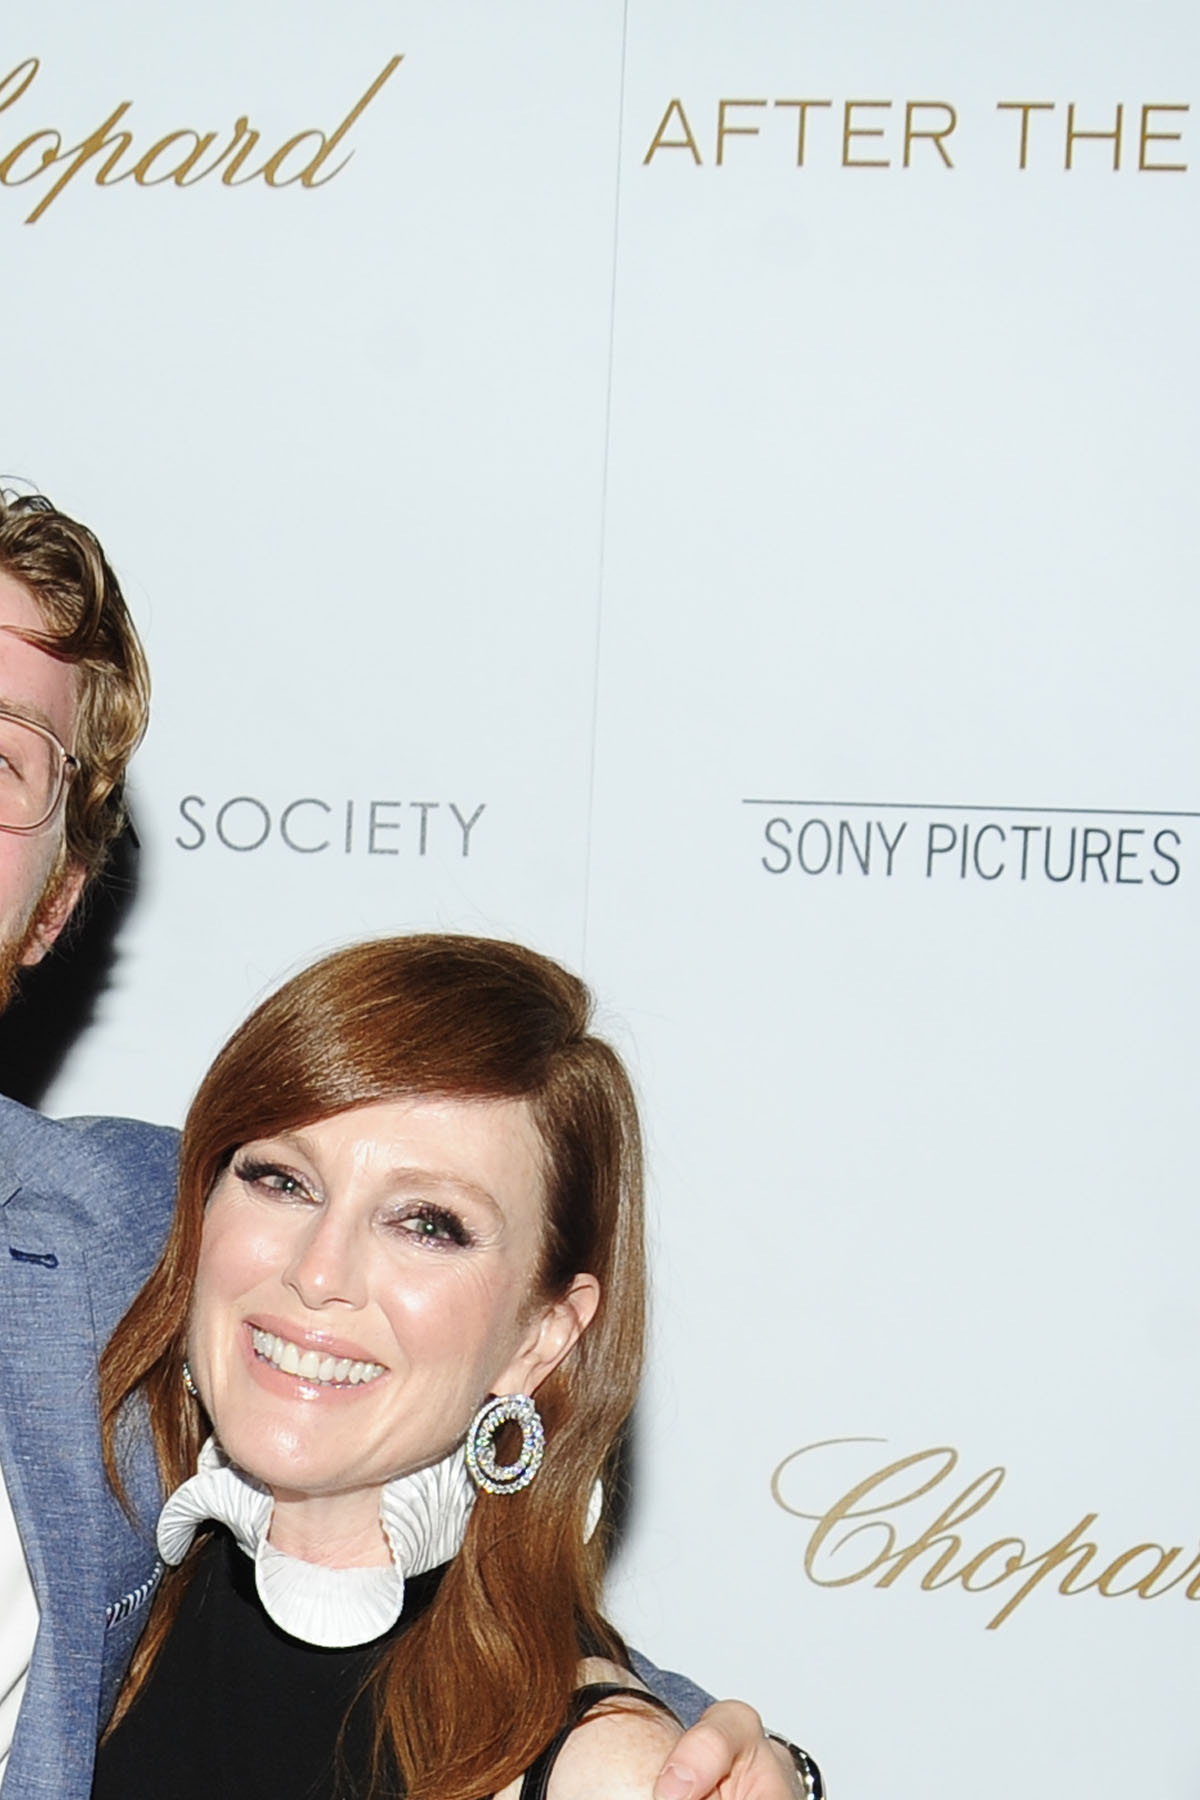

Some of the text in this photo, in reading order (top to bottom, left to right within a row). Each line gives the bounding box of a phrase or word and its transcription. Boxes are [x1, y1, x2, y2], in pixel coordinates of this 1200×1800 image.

[643, 98, 1190, 172] AFTER THE
[176, 795, 485, 856] SOCIETY
[762, 818, 1182, 886] SONY PICTURES
[771, 1438, 1200, 1630] Chopa
